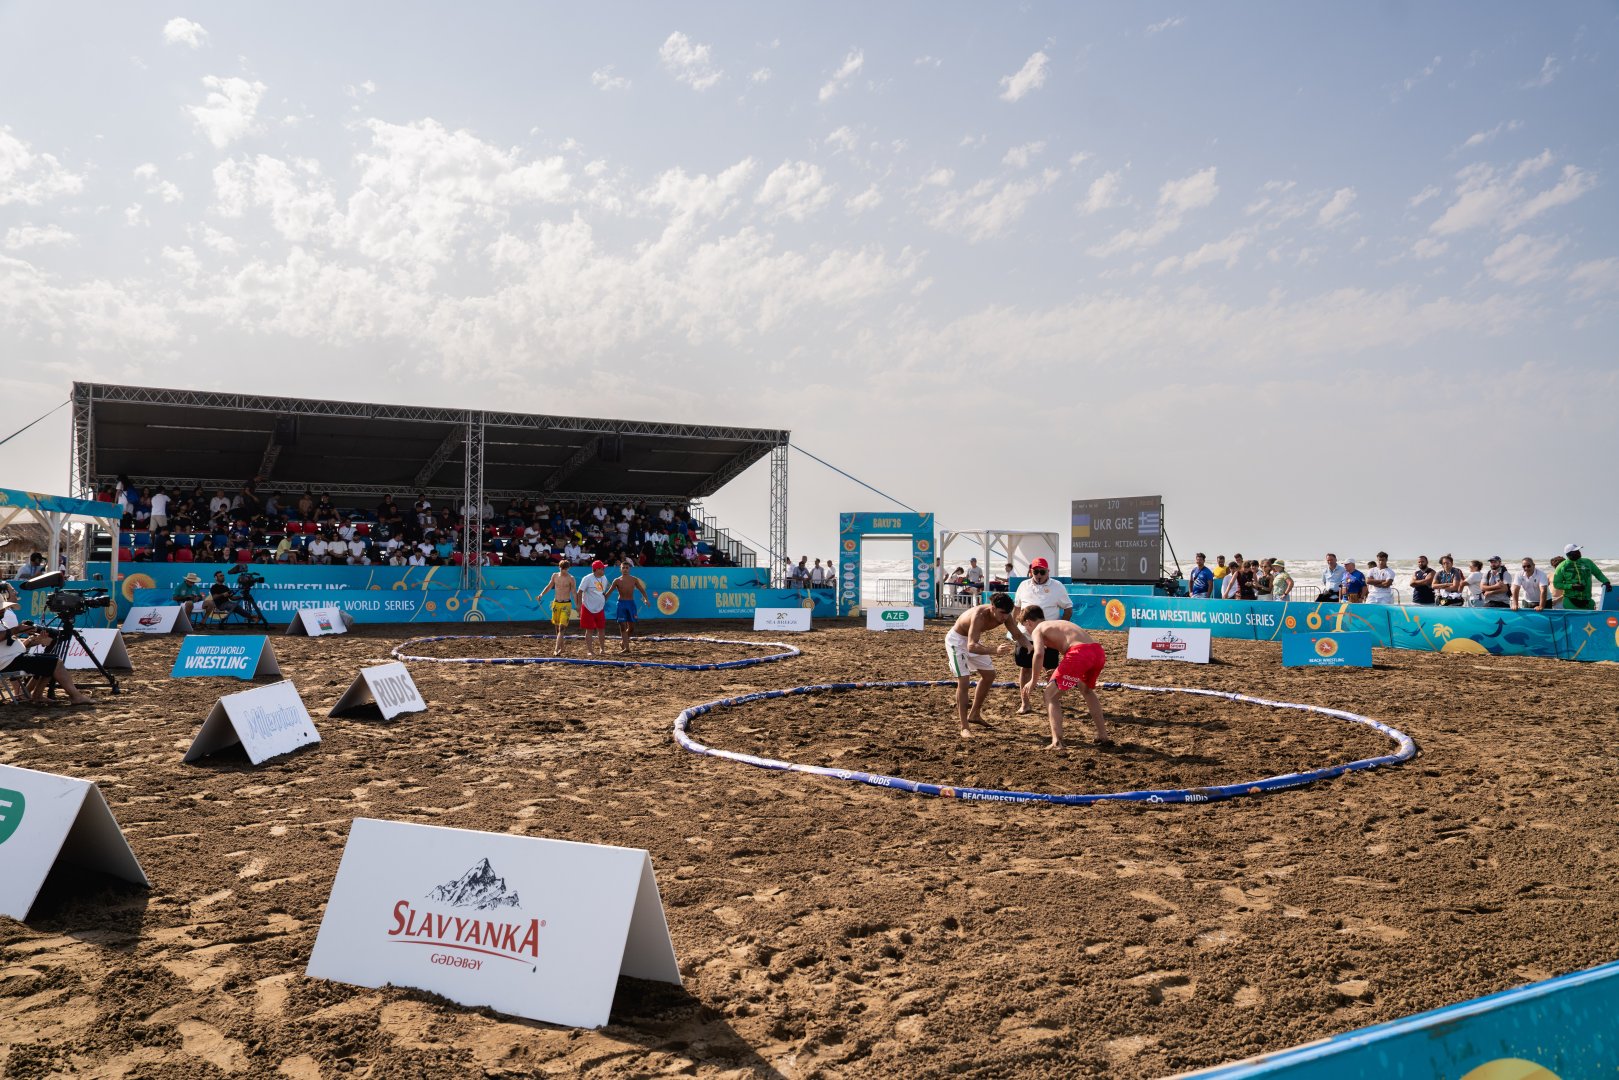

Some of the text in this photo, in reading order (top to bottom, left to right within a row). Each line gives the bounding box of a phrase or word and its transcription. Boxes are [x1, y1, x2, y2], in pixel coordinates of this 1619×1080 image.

[1108, 500, 1120, 509] 170
[1094, 517, 1134, 530] UKR GRE
[1081, 557, 1088, 573] 3
[1139, 557, 1147, 574] 0
[281, 600, 341, 611] WRESTLING
[344, 600, 380, 611] WORLD
[384, 600, 415, 611] SERIES
[715, 592, 757, 608] BAKU'26
[886, 612, 905, 620] AZE
[1131, 608, 1275, 627] BEACH WRESTLING WORLD SERIES
[195, 646, 246, 655] UNITED WORLD
[185, 656, 248, 669] WRESTLING
[372, 674, 416, 708] RUDIS
[868, 775, 891, 787] RUDIS
[1184, 793, 1208, 803] RUDIS
